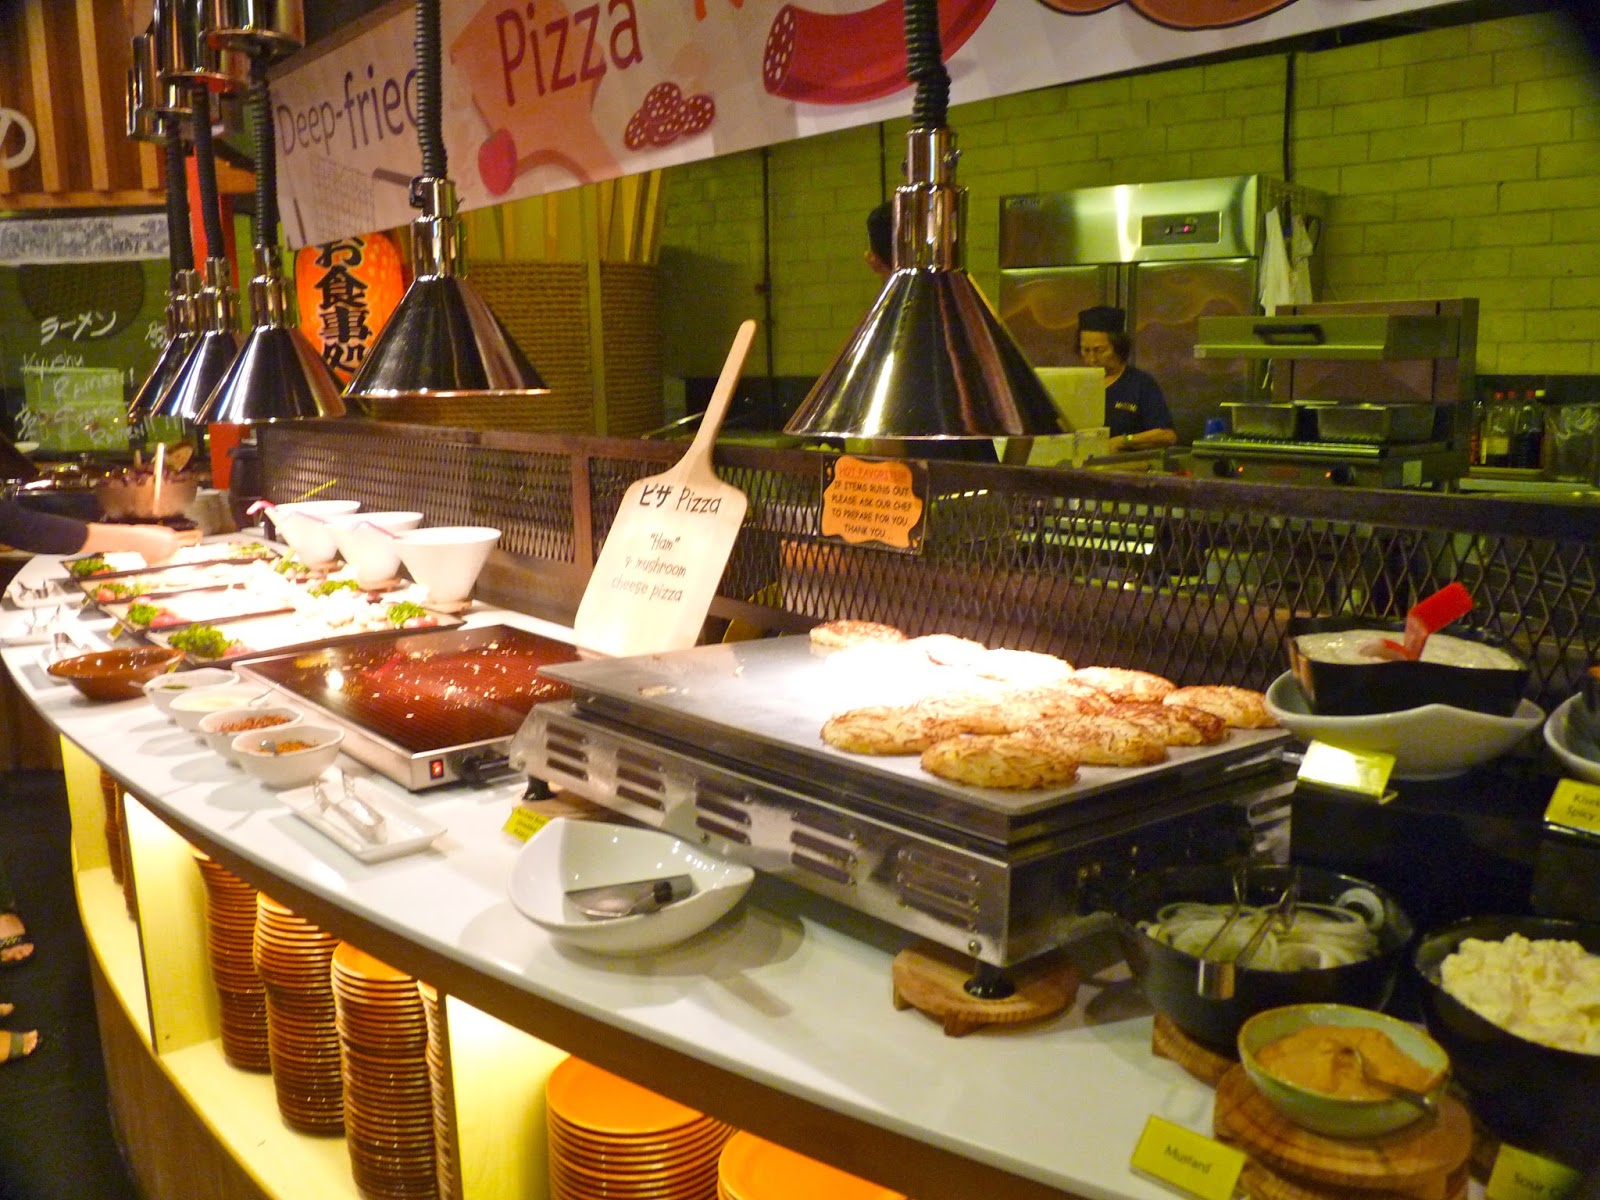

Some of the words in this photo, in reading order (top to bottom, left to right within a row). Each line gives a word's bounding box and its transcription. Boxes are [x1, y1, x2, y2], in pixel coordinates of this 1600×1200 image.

[496, 0, 643, 107] Pizza
[314, 236, 373, 373] お食事処
[40, 310, 117, 347] ラーメン
[675, 486, 722, 515] Pizza
[831, 493, 858, 507] PLEASE
[859, 497, 874, 508] ASK
[875, 498, 891, 509] OUR
[831, 507, 842, 518] TO
[843, 508, 873, 523] PREPARE
[874, 512, 890, 525] FOR
[844, 523, 869, 536] THANK
[636, 557, 686, 577] mushroom
[612, 574, 648, 595] cheese
[649, 584, 683, 601] pizza
[1163, 1143, 1213, 1175] Mustard
